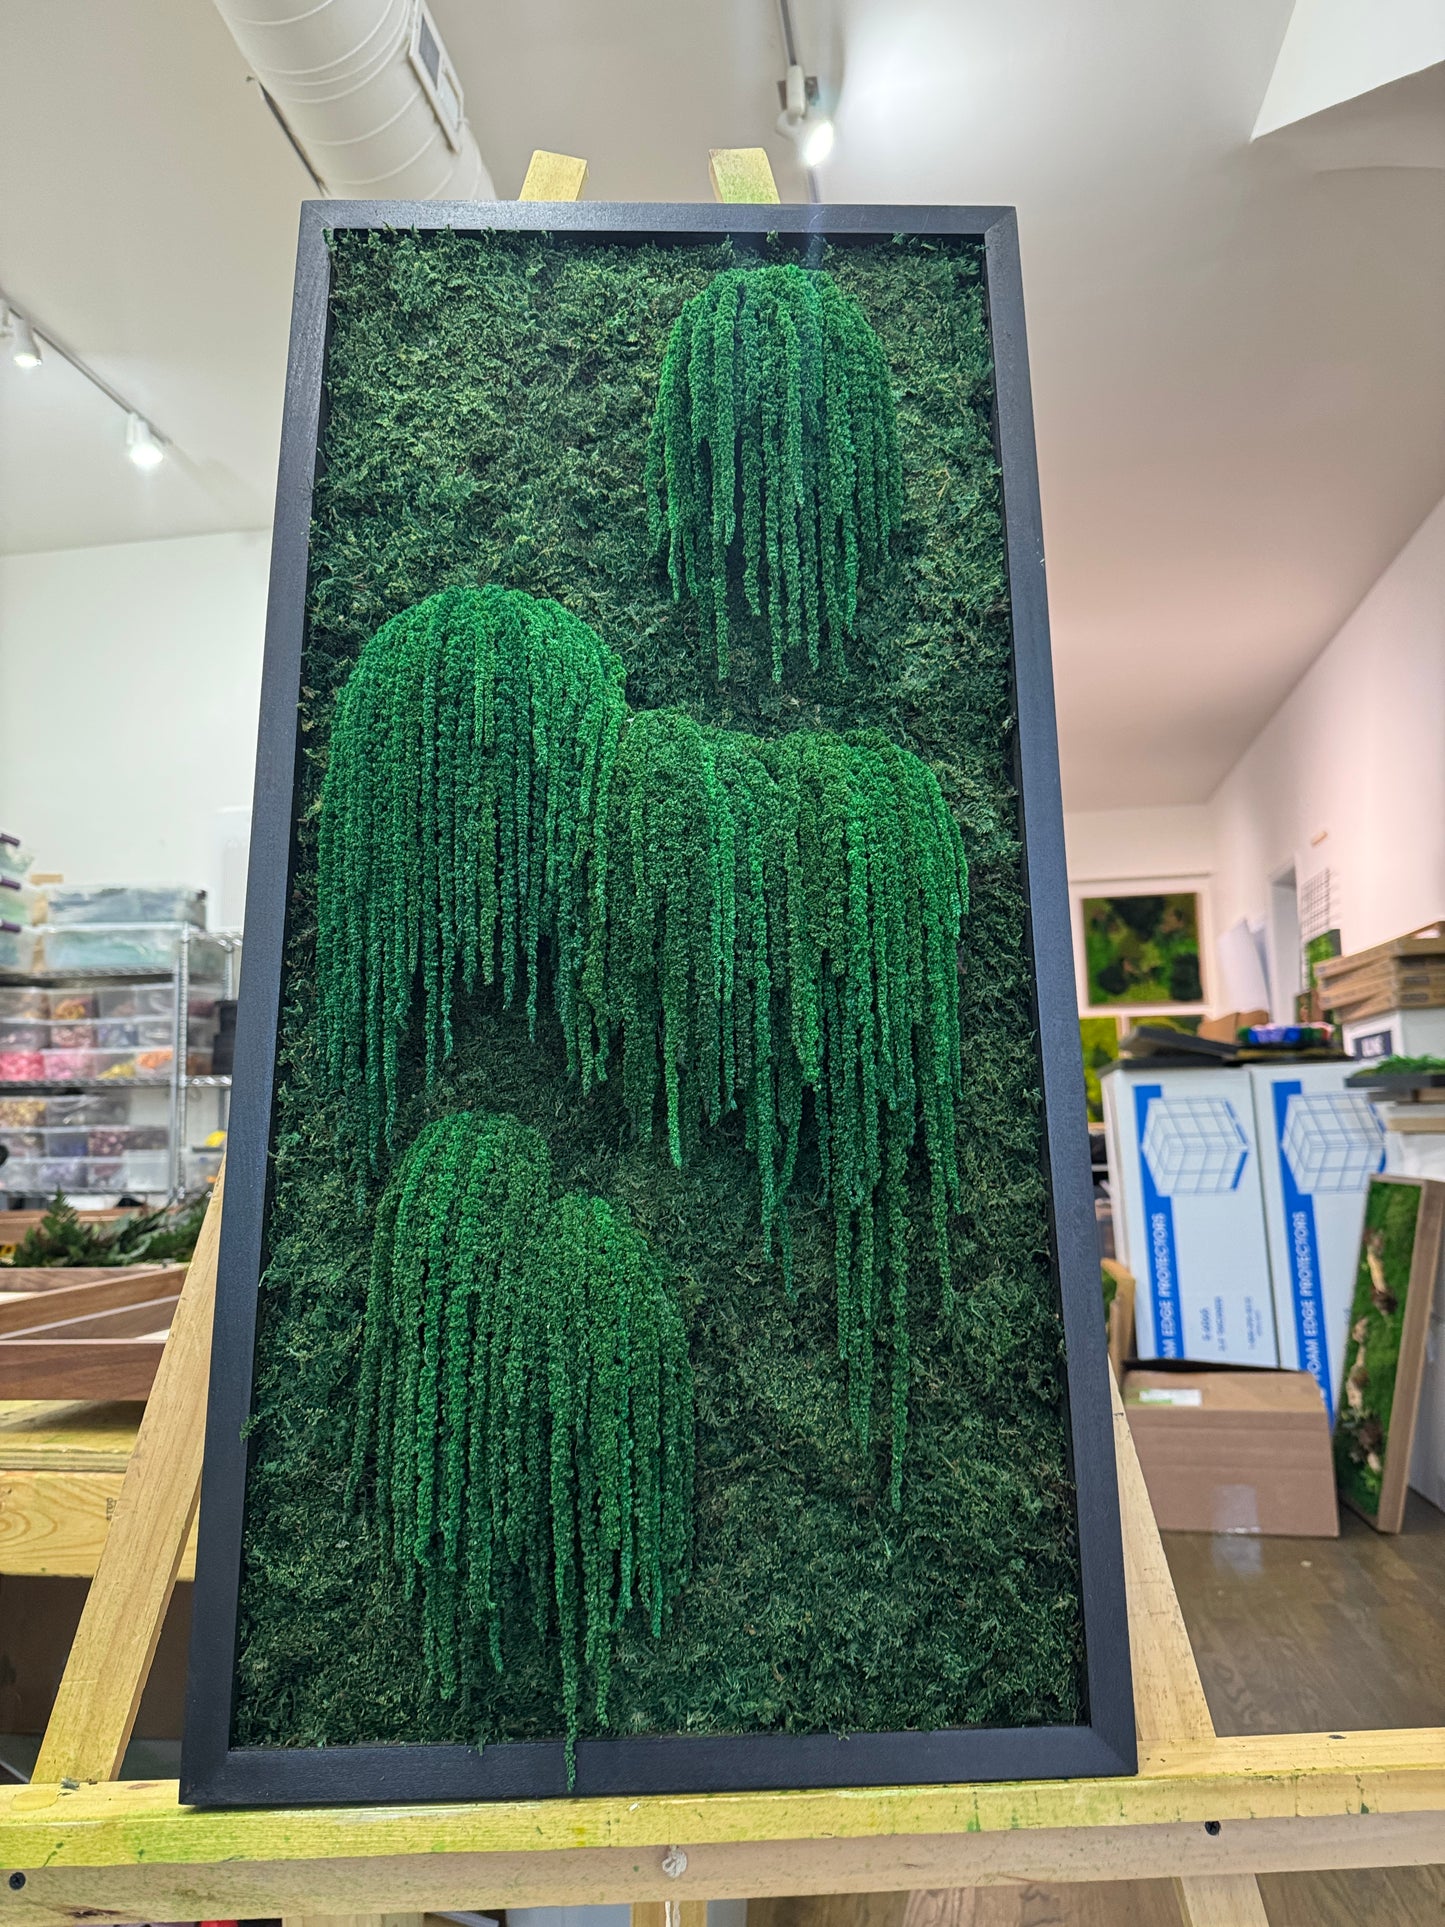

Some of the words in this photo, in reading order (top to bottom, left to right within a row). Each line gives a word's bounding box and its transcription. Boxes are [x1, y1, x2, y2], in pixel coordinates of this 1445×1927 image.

[1152, 1212, 1172, 1297] PROTECTORS
[1292, 1211, 1313, 1297] PROTECTORS
[1159, 1300, 1176, 1337] EDGE
[1301, 1300, 1318, 1337] EDGE
[1162, 1338, 1177, 1359] AM
